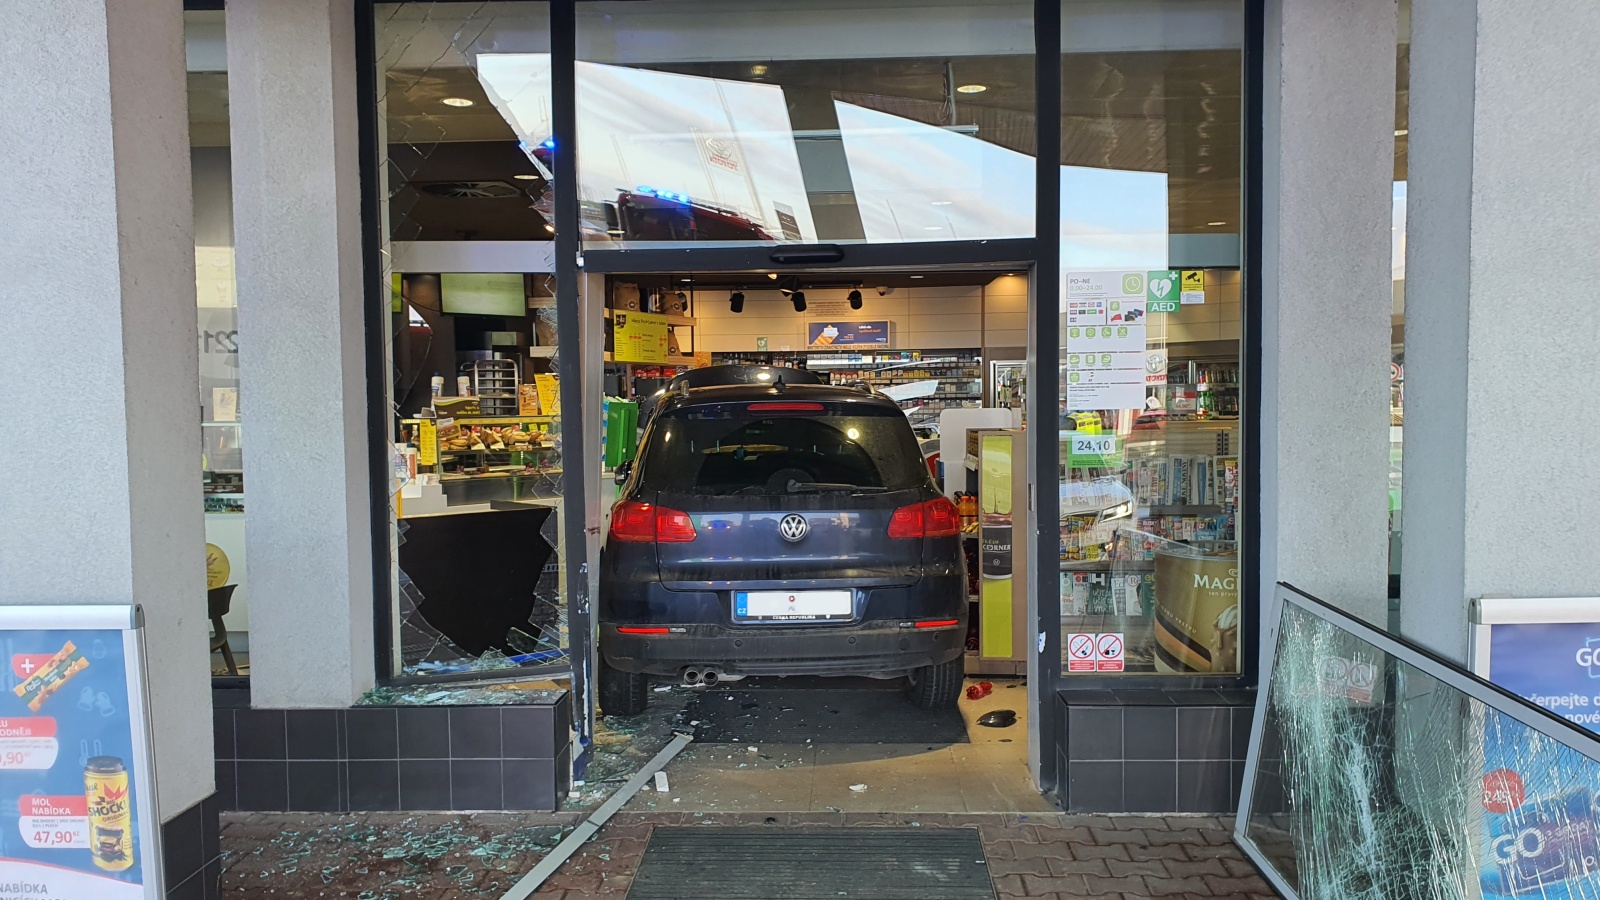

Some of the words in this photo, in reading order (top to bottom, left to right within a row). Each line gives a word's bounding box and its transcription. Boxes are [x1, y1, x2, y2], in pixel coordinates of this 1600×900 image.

[1151, 302, 1175, 312] AED
[1077, 440, 1110, 452] 24,10
[1193, 573, 1238, 590] MAG
[1525, 692, 1589, 710] čerpejte
[0, 752, 24, 766] ,90
[32, 797, 51, 806] MOL
[32, 806, 71, 815] NABÍDKA
[33, 831, 72, 846] 47,90
